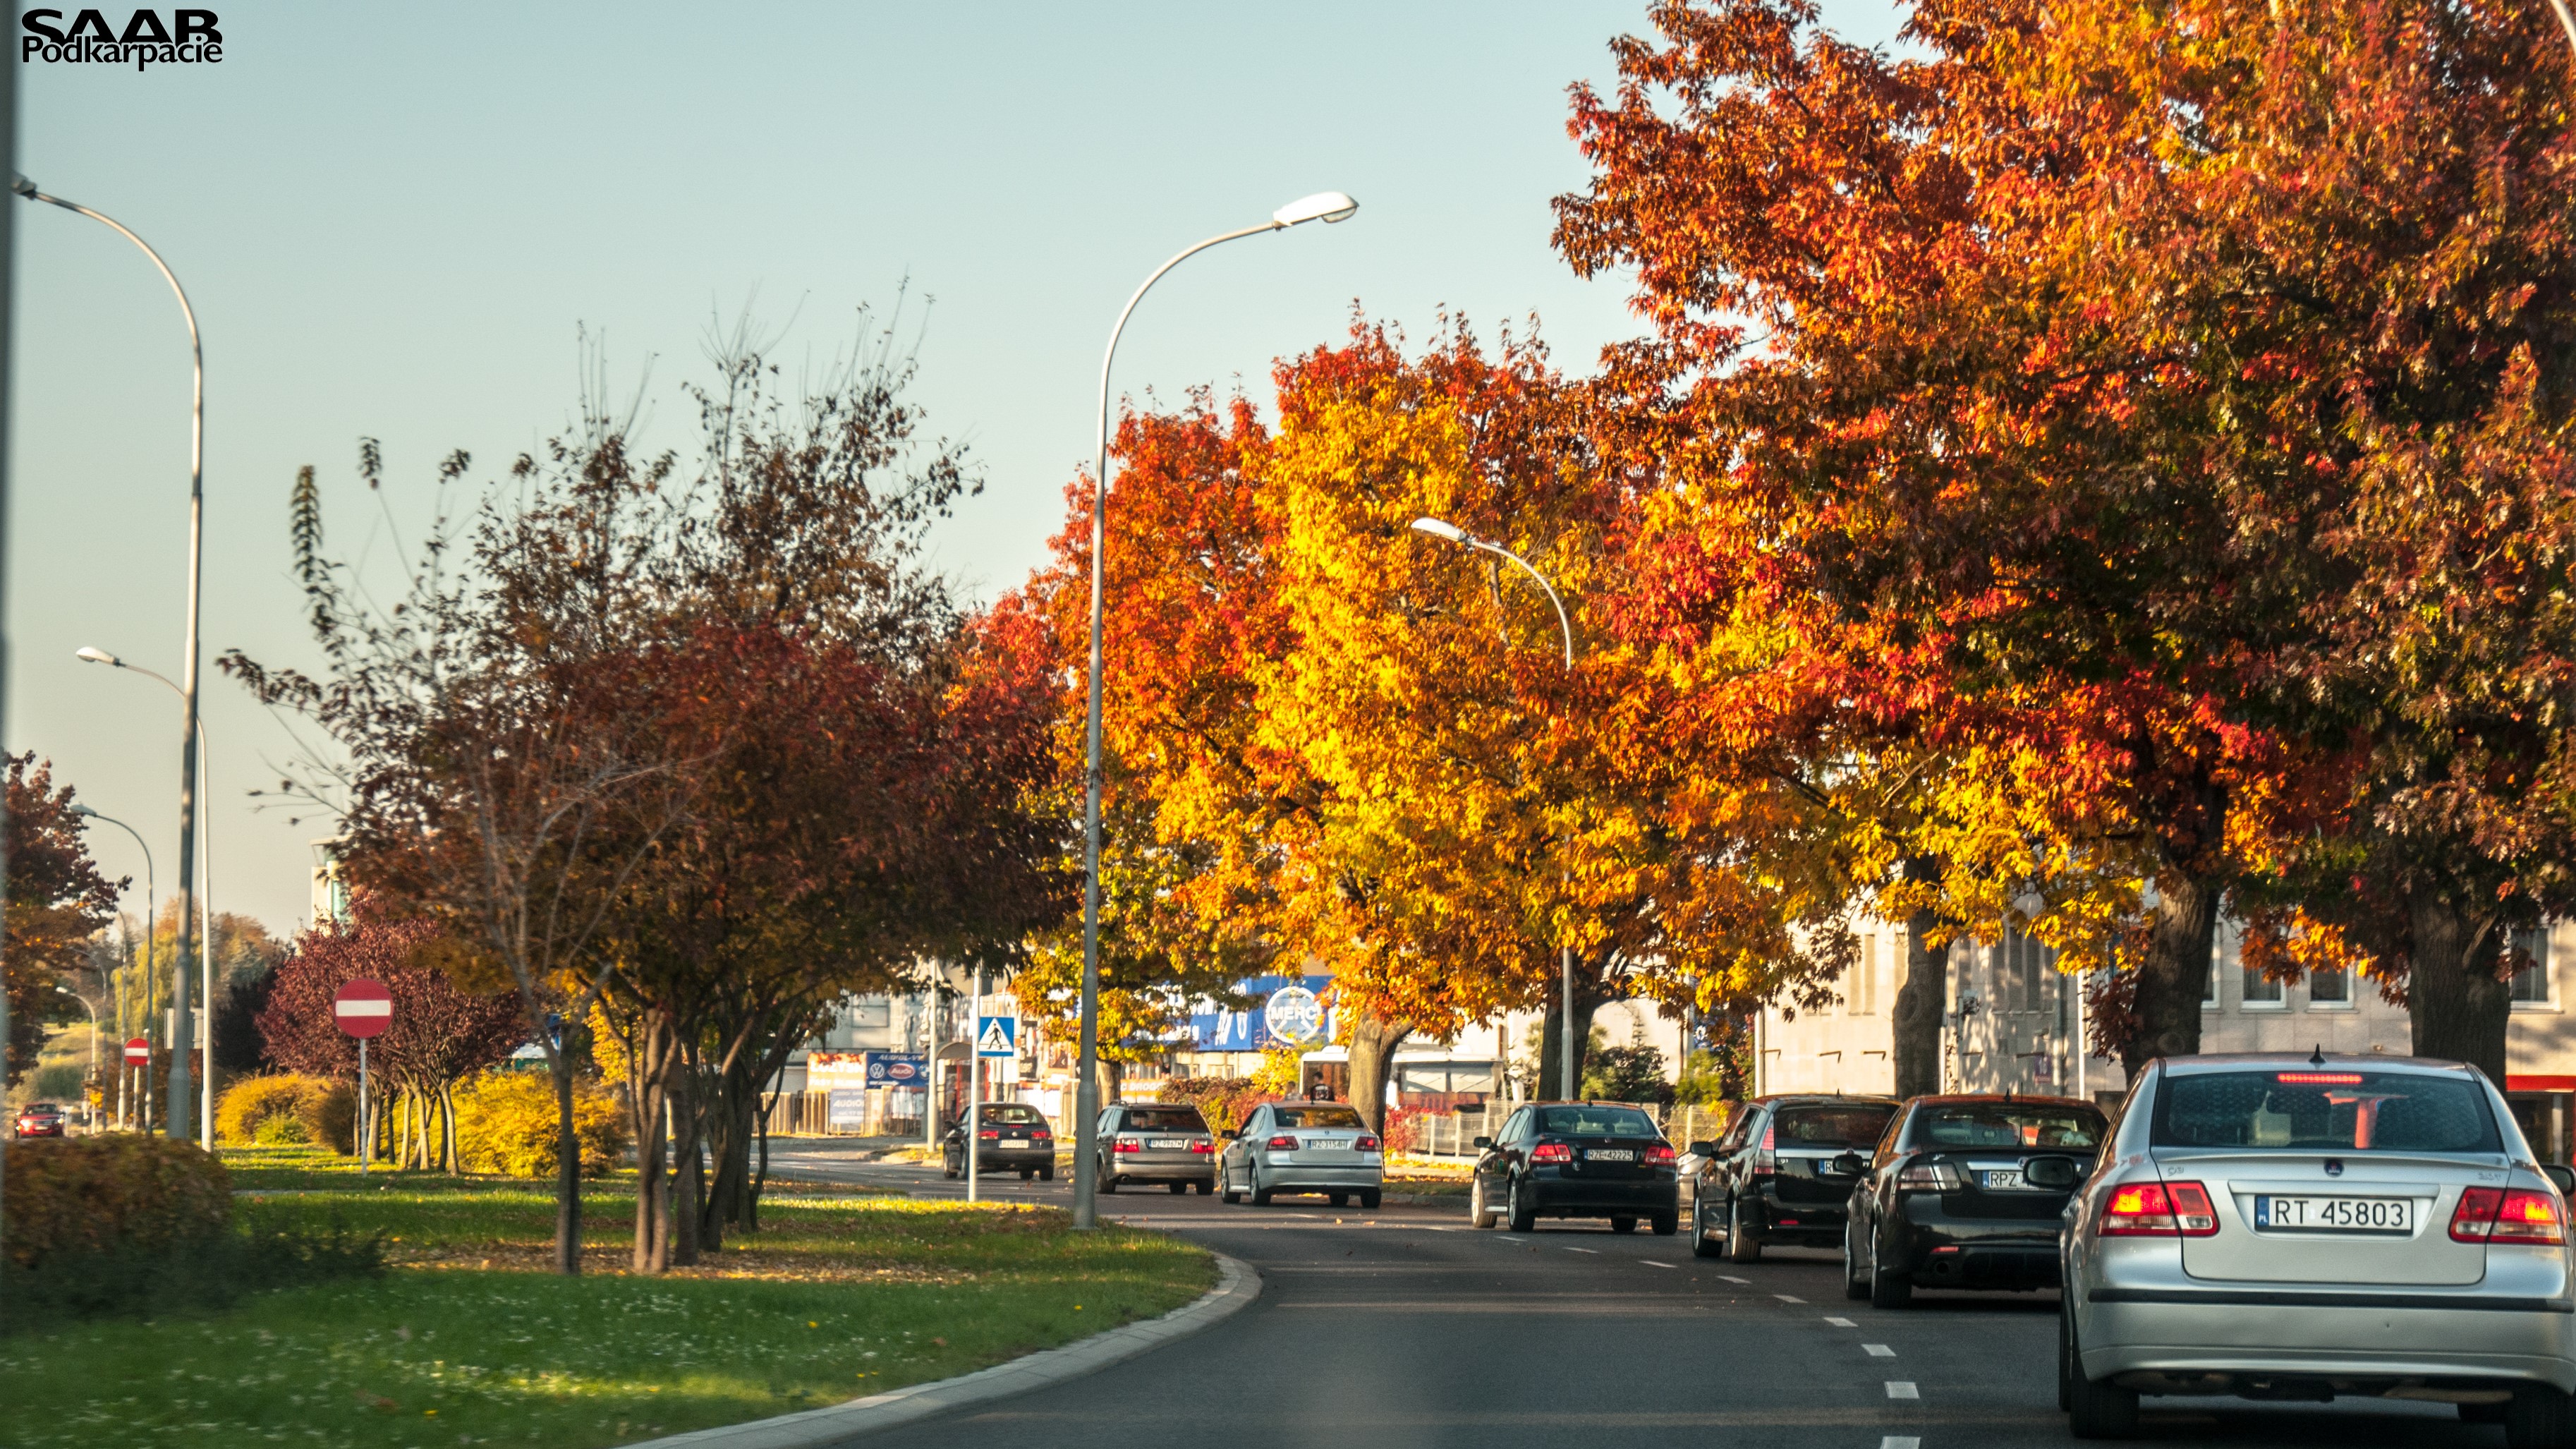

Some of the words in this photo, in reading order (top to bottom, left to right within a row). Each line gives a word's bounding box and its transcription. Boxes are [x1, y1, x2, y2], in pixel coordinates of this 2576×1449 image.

[1270, 1005, 1317, 1020] MERC
[1312, 1140, 1322, 1148] RZ
[1588, 1151, 1605, 1159] RZE
[1608, 1151, 1632, 1160] 42225
[1991, 1172, 2017, 1187] RPZ
[2276, 1200, 2309, 1225] RT
[2321, 1201, 2404, 1227] 45803
